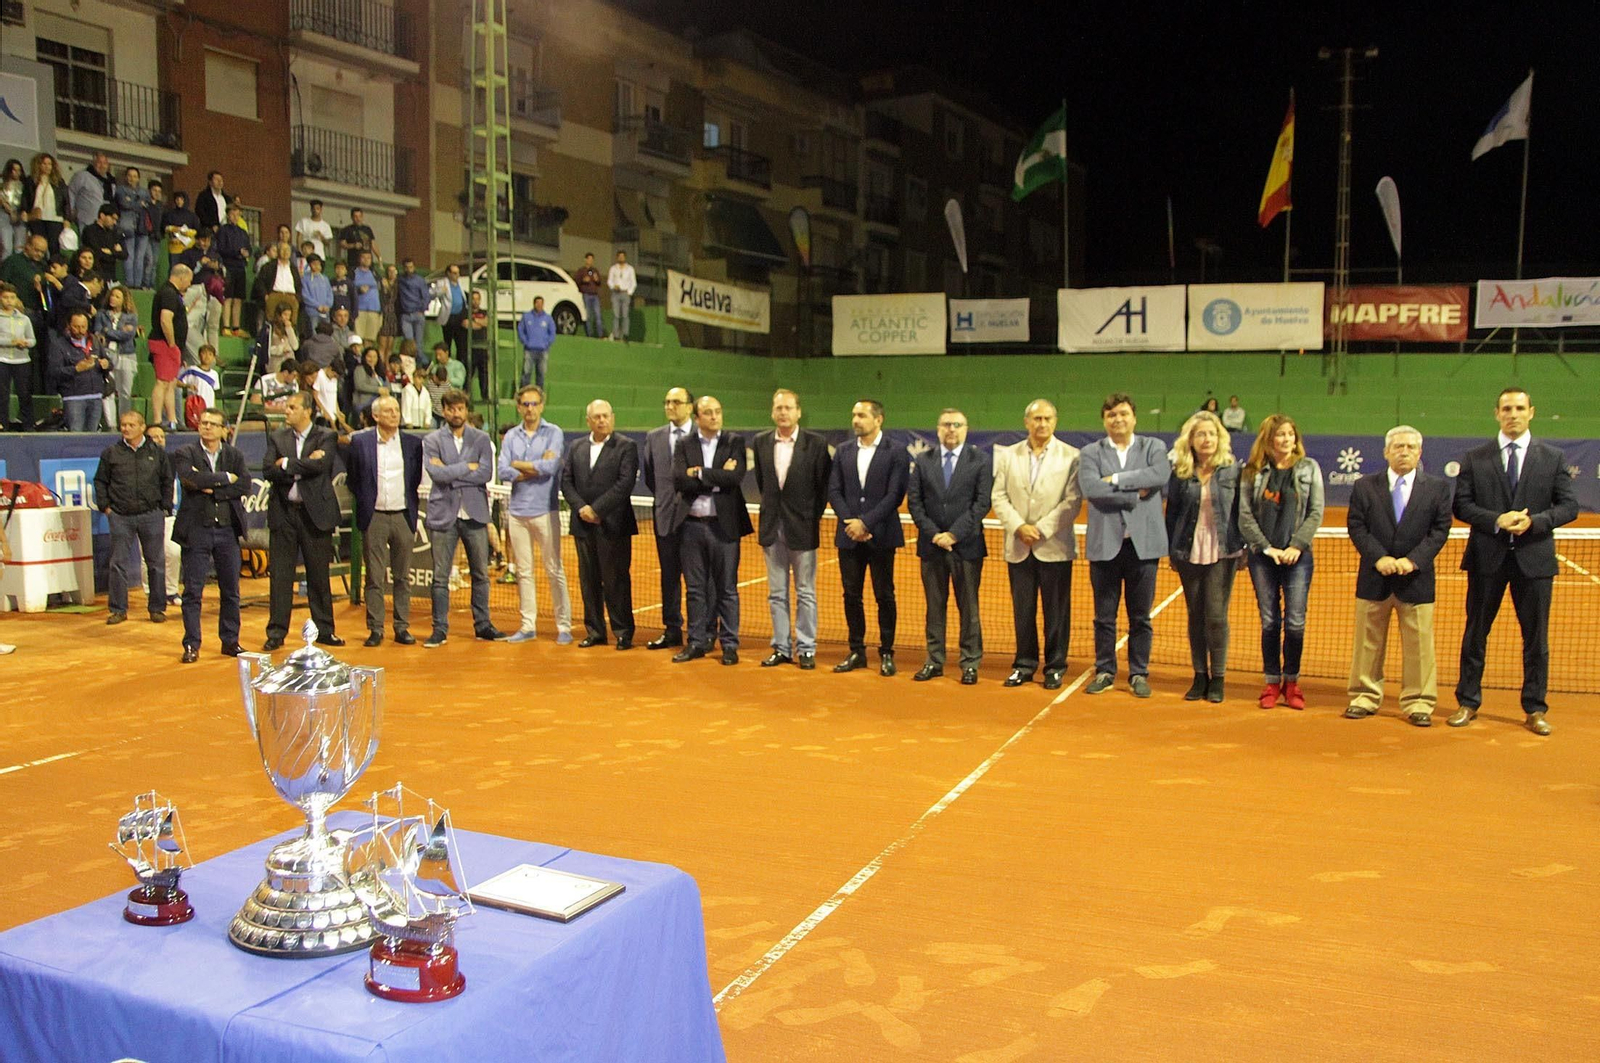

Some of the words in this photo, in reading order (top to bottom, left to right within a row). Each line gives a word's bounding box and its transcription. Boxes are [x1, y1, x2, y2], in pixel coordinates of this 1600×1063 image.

[680, 279, 731, 313] Huelva
[1095, 296, 1147, 334] AH
[1244, 306, 1310, 316] Ayuntamiento
[1330, 303, 1461, 325] MAPFRE
[849, 316, 929, 330] ATLANTIC
[858, 329, 918, 343] COPPER
